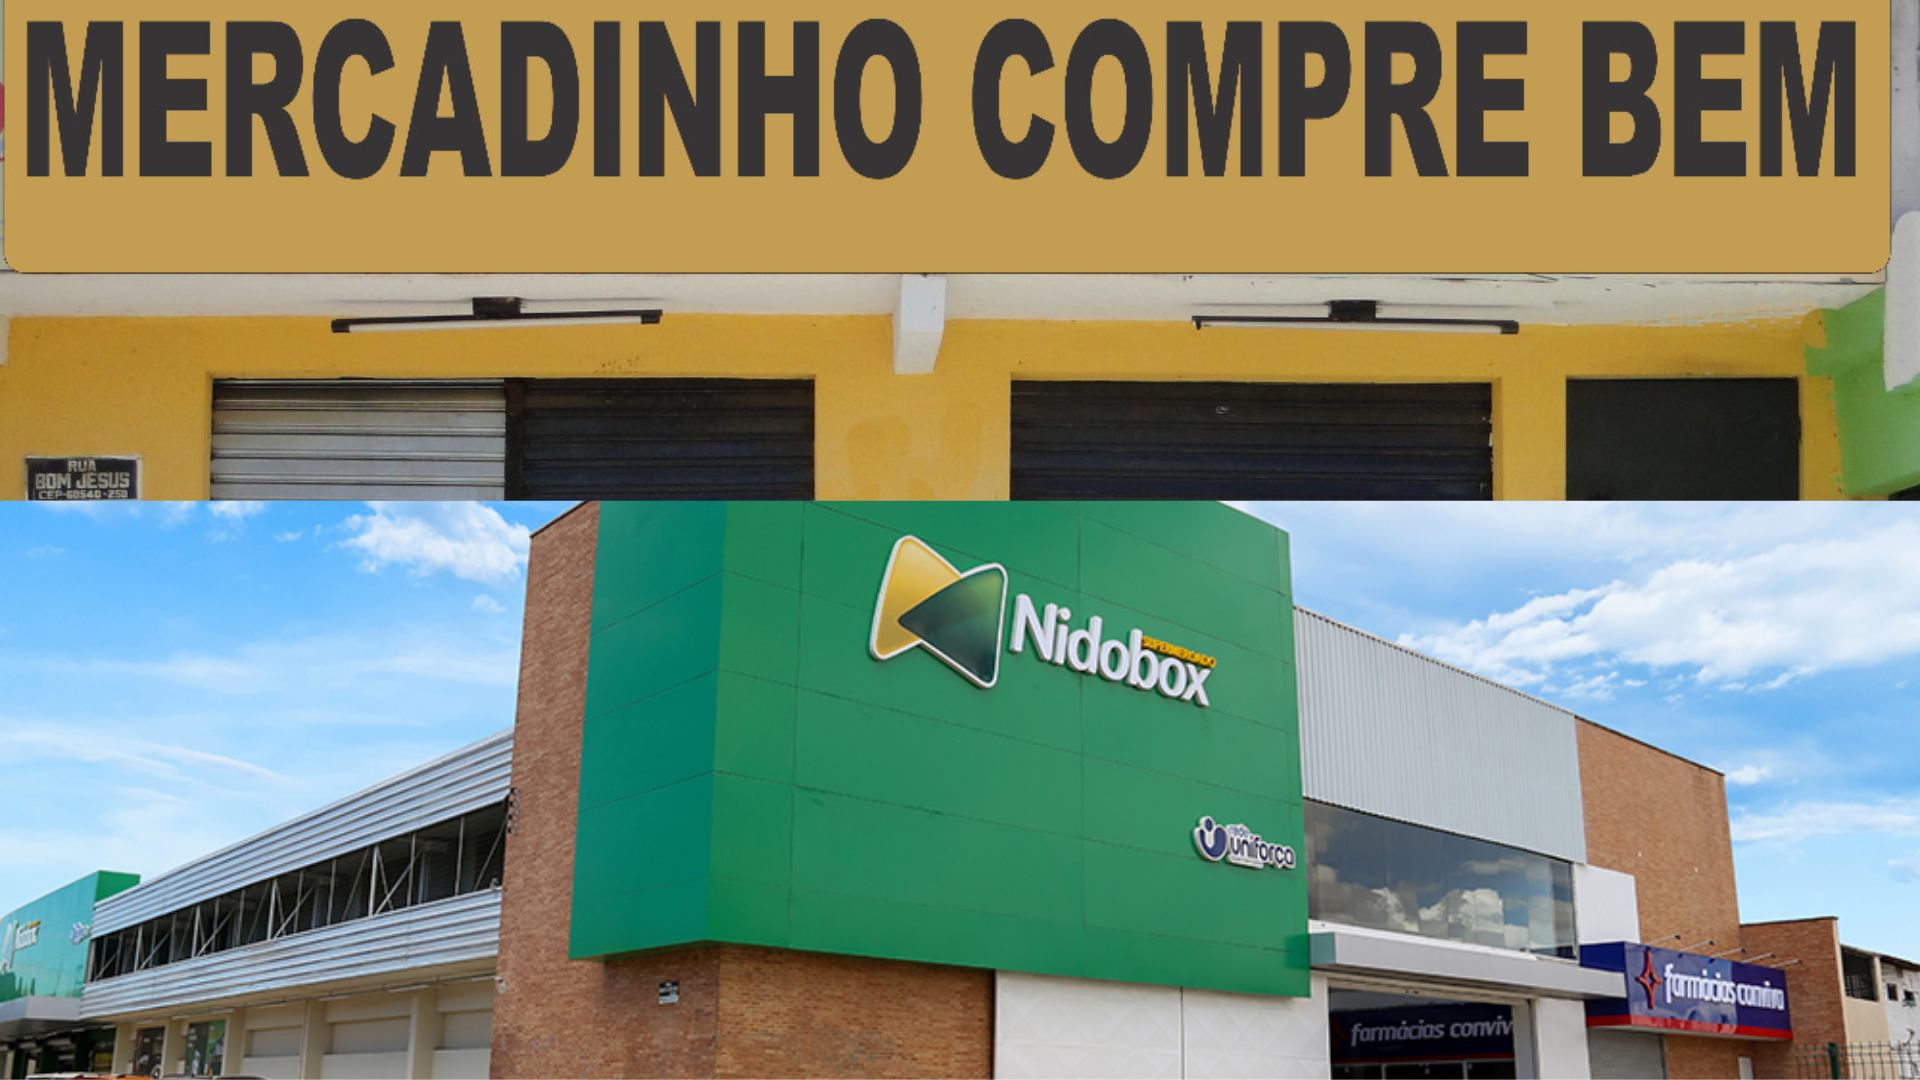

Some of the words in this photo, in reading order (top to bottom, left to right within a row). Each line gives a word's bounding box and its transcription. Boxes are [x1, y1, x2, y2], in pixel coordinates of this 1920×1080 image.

[26, 18, 922, 180] MERCADINHO
[971, 18, 1529, 180] COMPRE
[1582, 20, 1857, 178] BEM
[67, 460, 97, 473] RUA
[35, 472, 72, 490] BOM
[75, 471, 130, 490] JESUS
[1010, 594, 1210, 707] Nidobox
[1449, 1015, 1514, 1038] conviv
